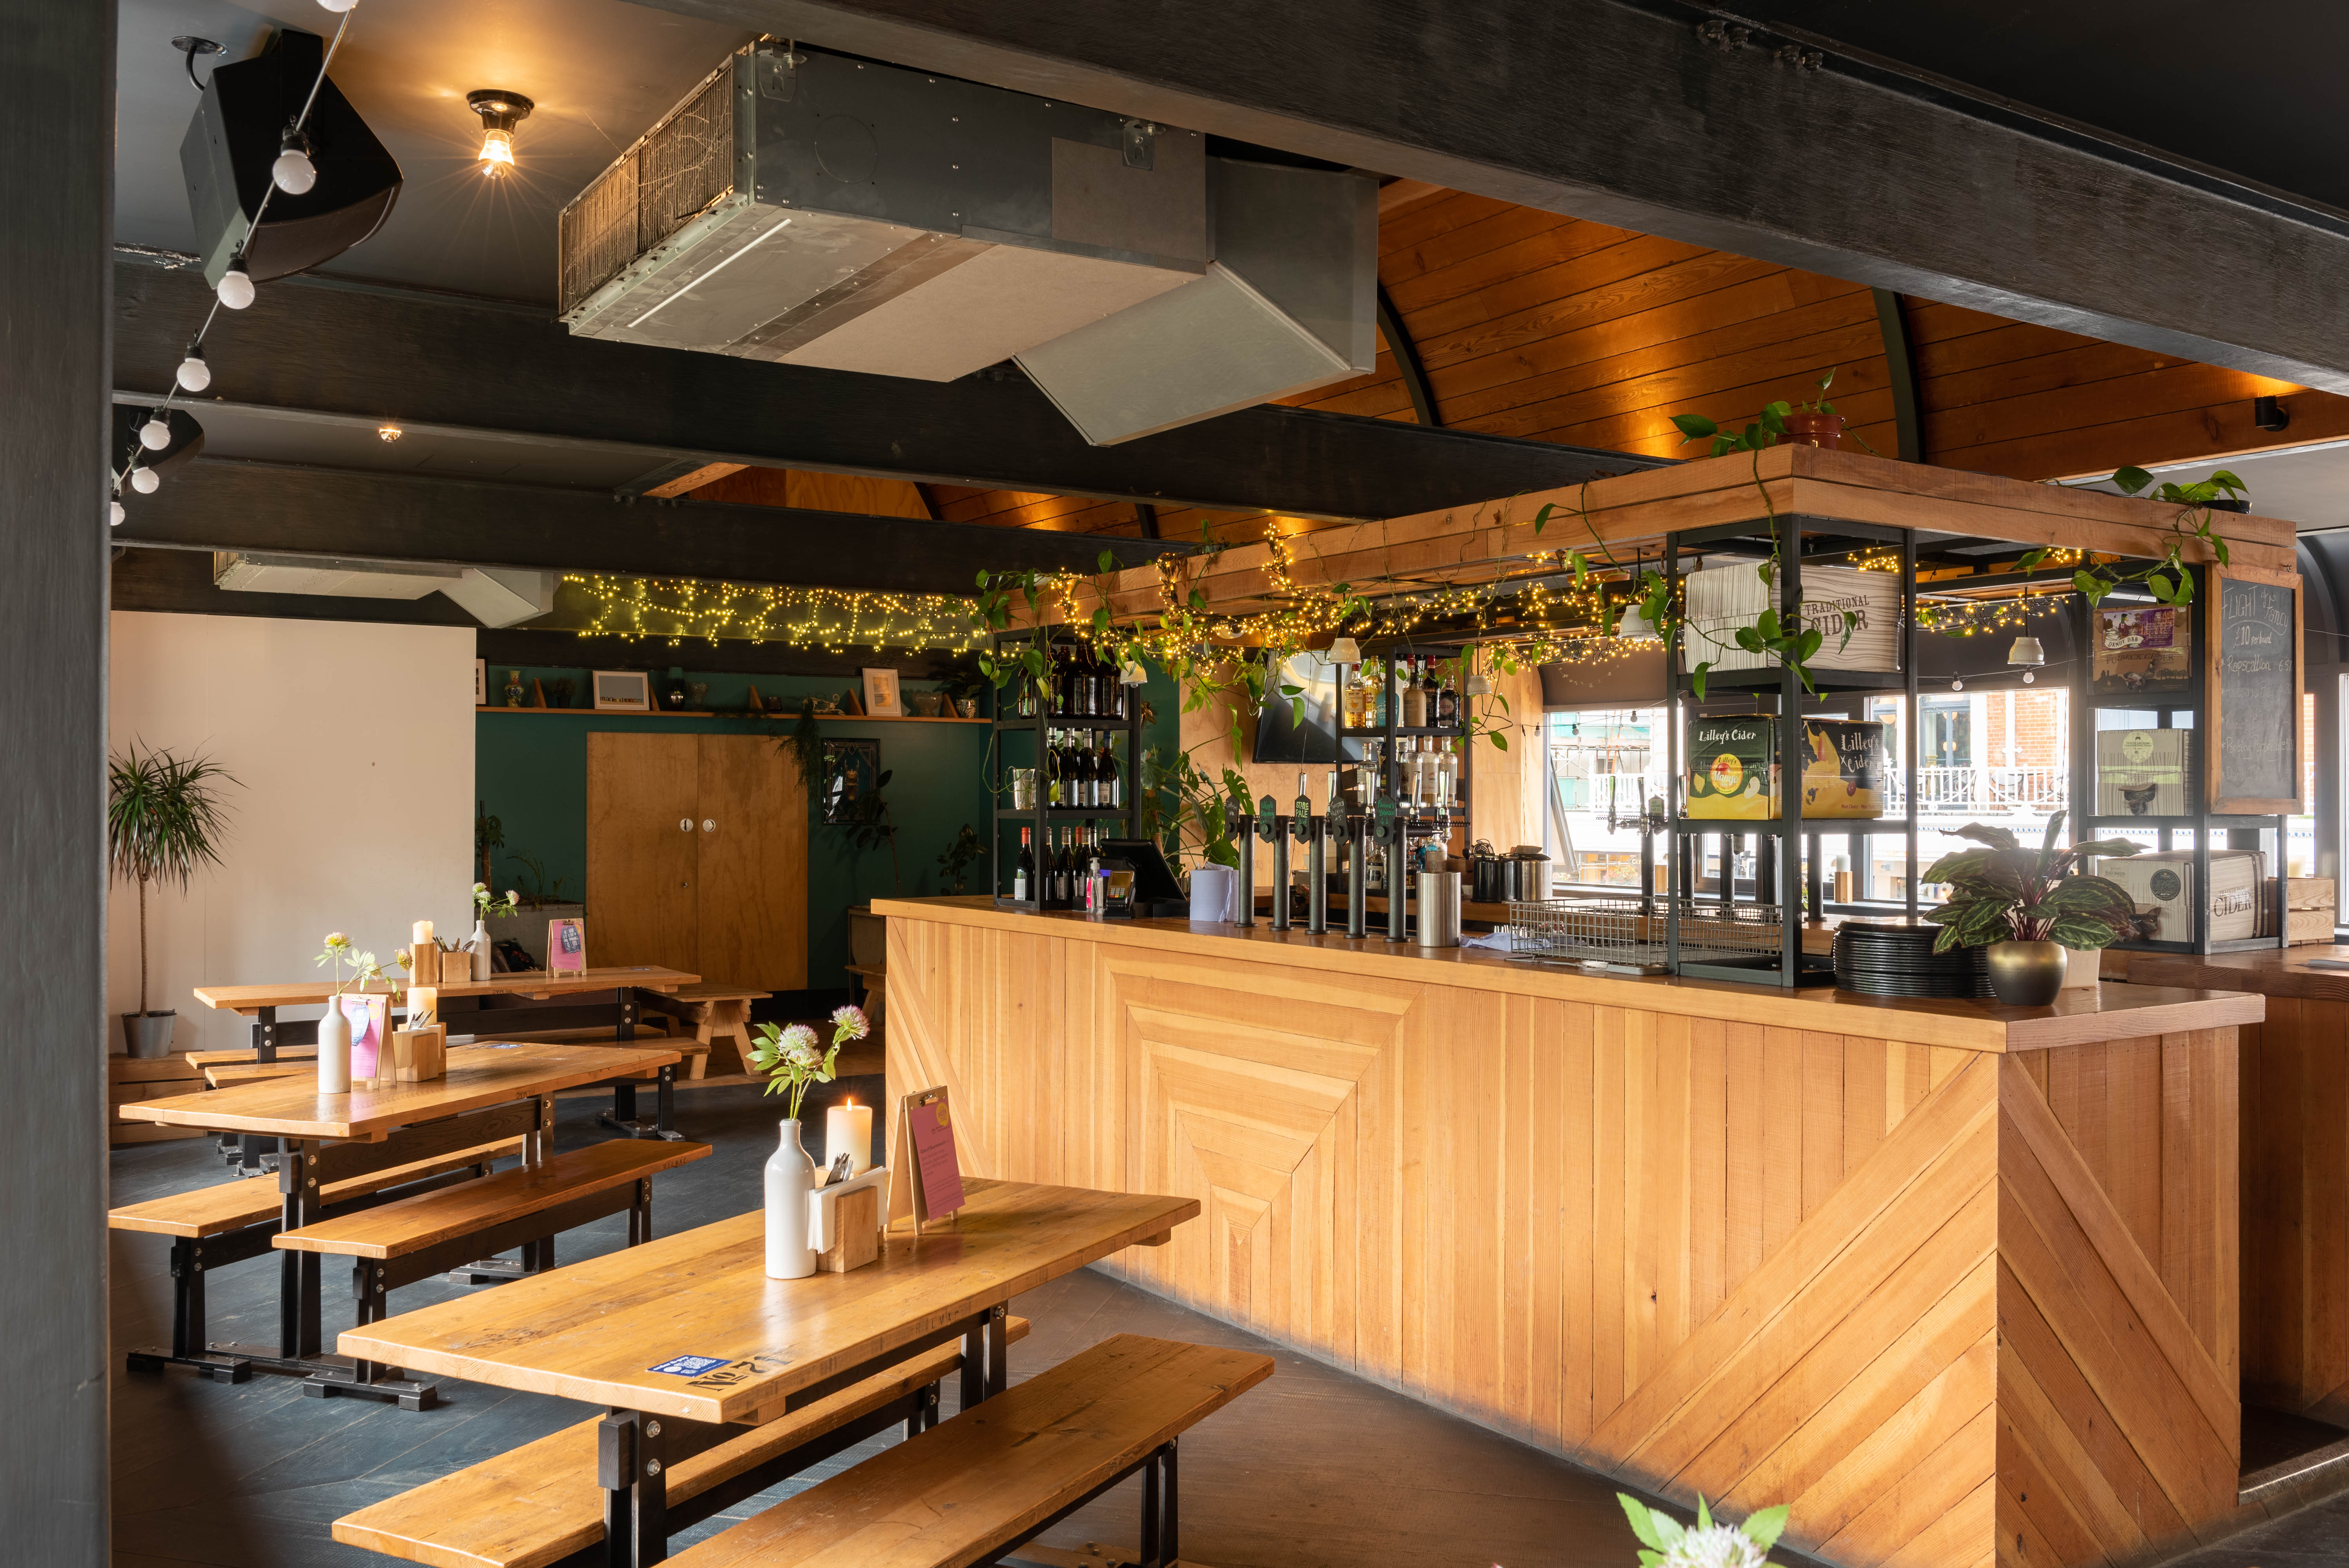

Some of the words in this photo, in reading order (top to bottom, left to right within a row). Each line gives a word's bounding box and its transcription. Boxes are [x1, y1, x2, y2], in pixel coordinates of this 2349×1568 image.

[1805, 595, 1869, 615] TRADITIONAL
[2221, 586, 2258, 619] FLIGHT
[2261, 588, 2268, 608] of
[2264, 594, 2289, 629] Fancy
[1811, 610, 1868, 636] CIDR
[2233, 626, 2250, 648] £10
[2259, 631, 2272, 644] board
[2227, 654, 2271, 676] Rapscallion
[1699, 729, 1729, 745] Lilley's
[1732, 729, 1756, 740] Cider
[1841, 732, 1879, 756] Lilley's
[1848, 754, 1874, 773] Cider
[1712, 770, 1739, 786] Mango
[1296, 801, 1308, 810] STABLE
[1296, 809, 1308, 818] PALE
[2214, 891, 2251, 917] CIDER
